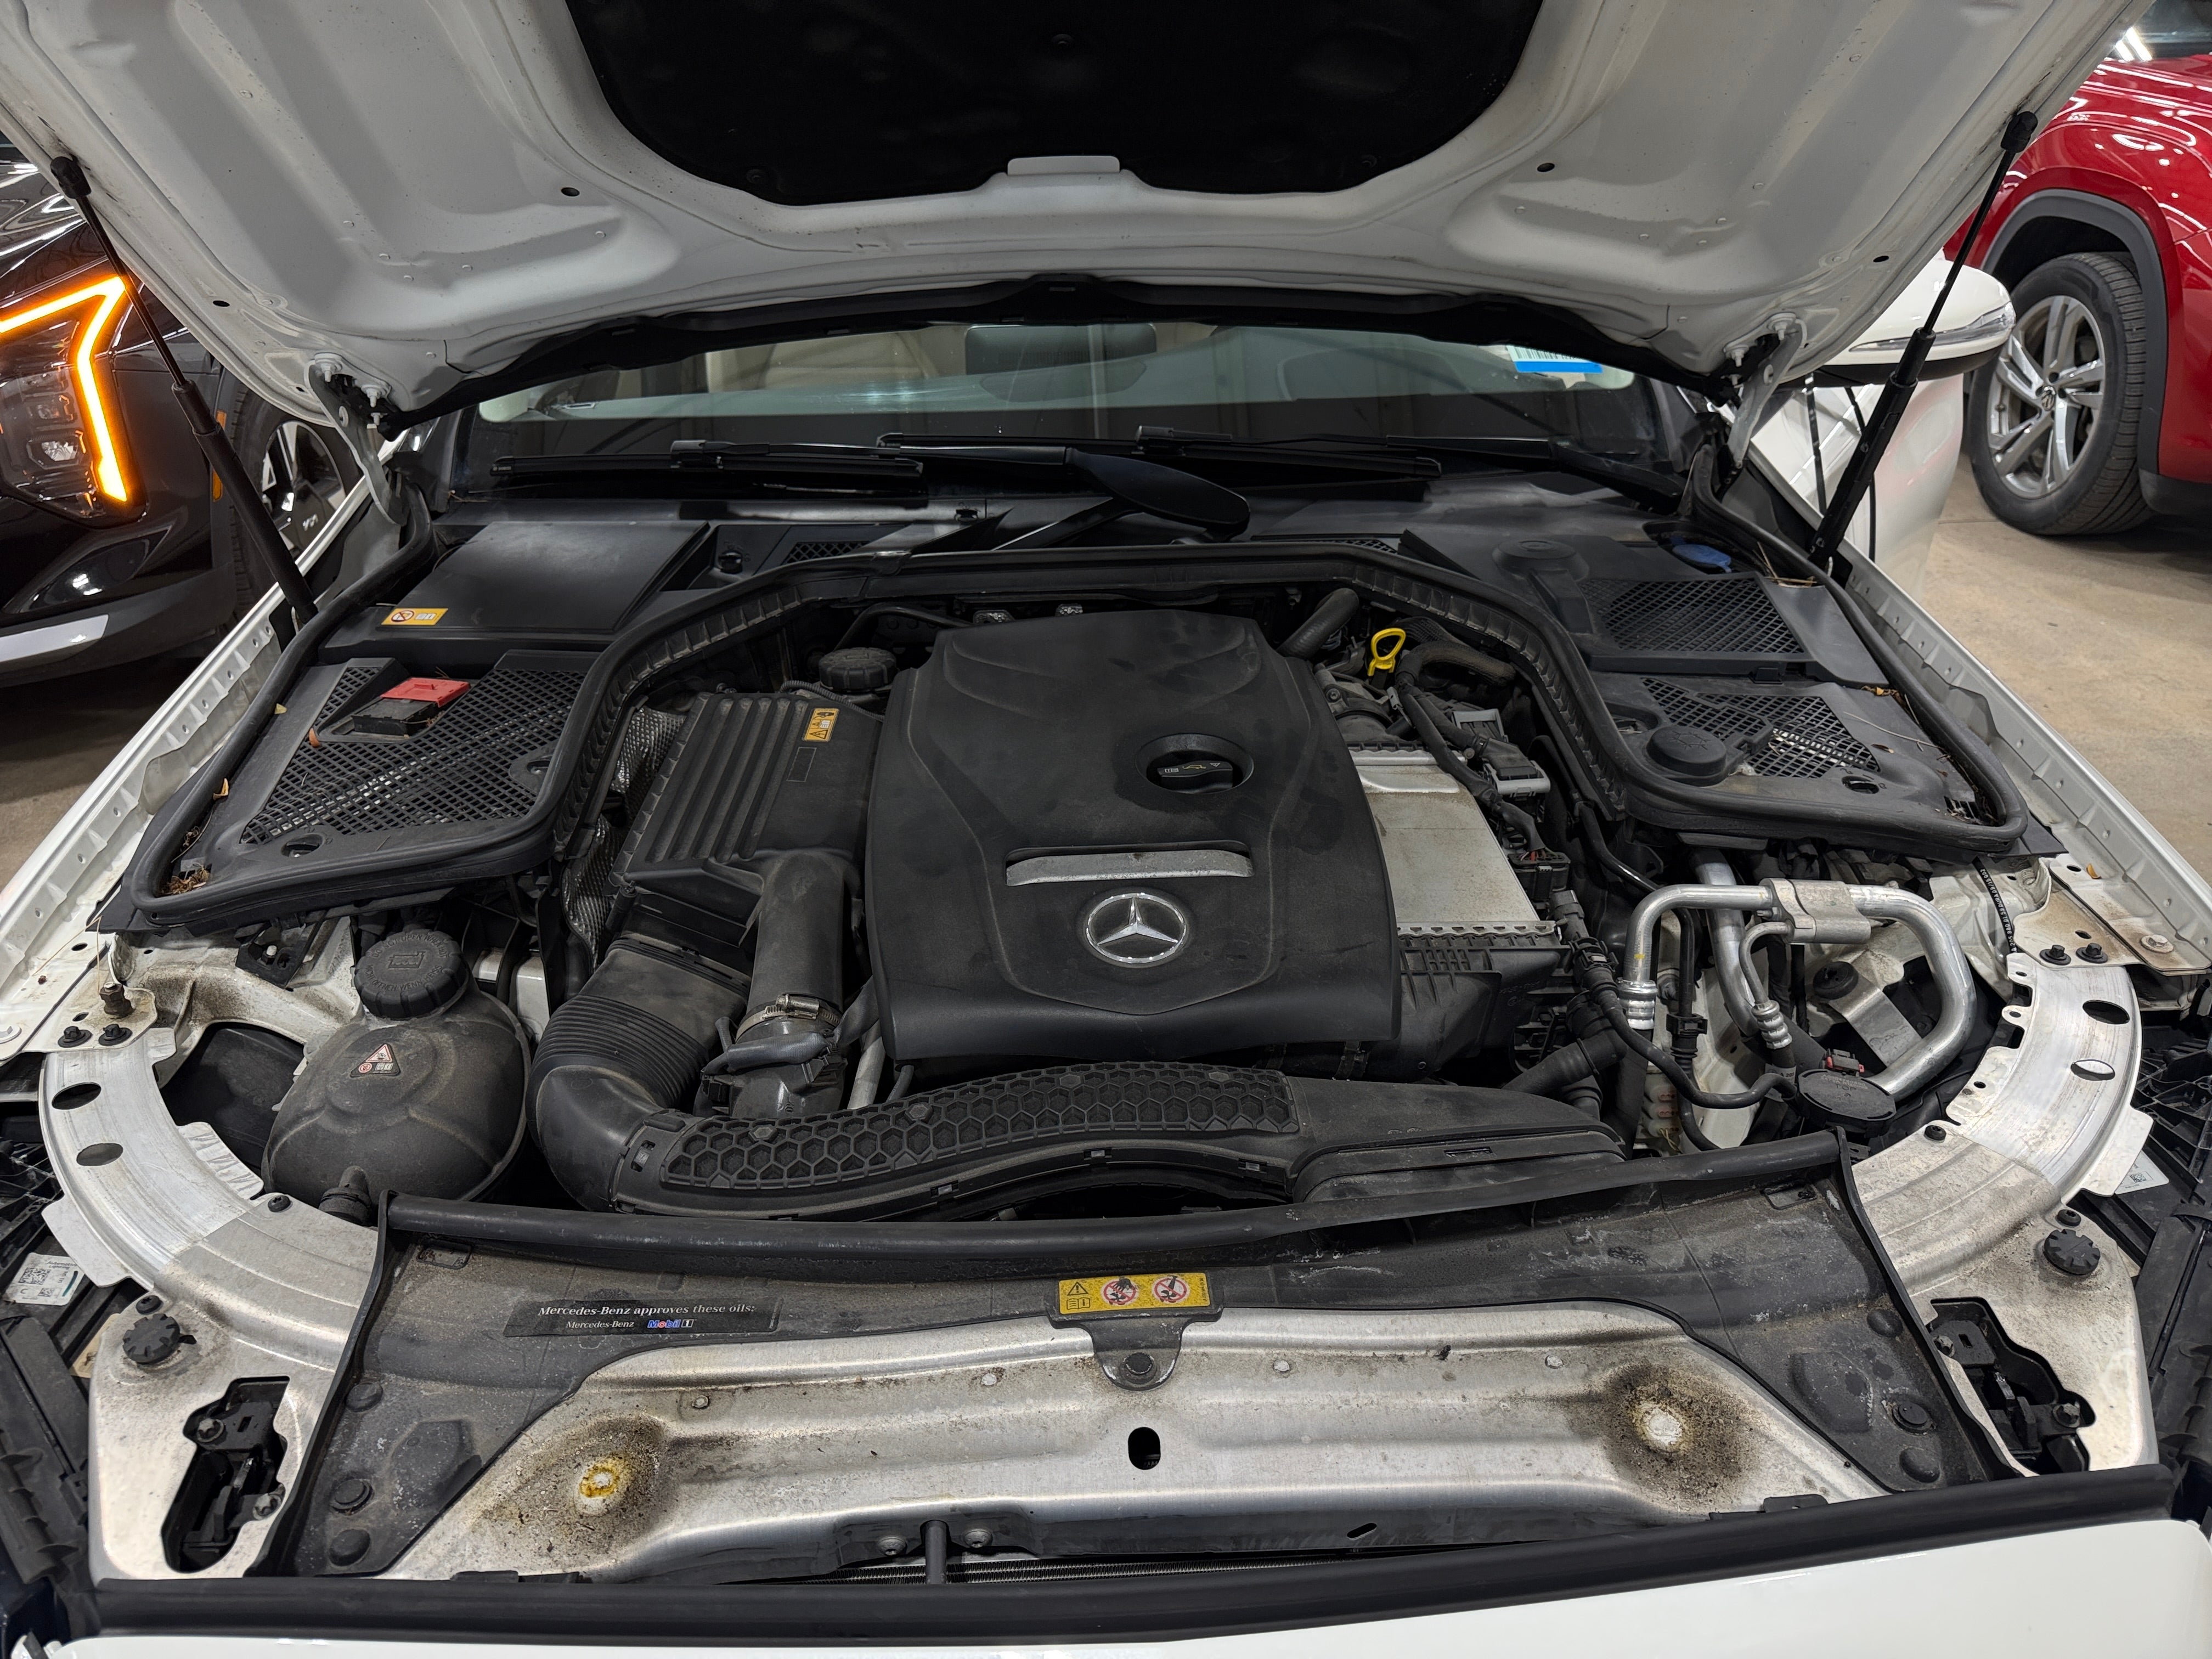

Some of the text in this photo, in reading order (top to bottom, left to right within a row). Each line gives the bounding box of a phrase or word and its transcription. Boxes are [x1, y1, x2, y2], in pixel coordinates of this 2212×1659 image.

[1994, 893, 2004, 907] DURA
[400, 934, 422, 942] OPEN
[424, 934, 443, 947] WHEN
[399, 979, 422, 991] WENN
[538, 1304, 755, 1316] Mercedes-Benz approves these oils:
[647, 1319, 681, 1328] Mobil
